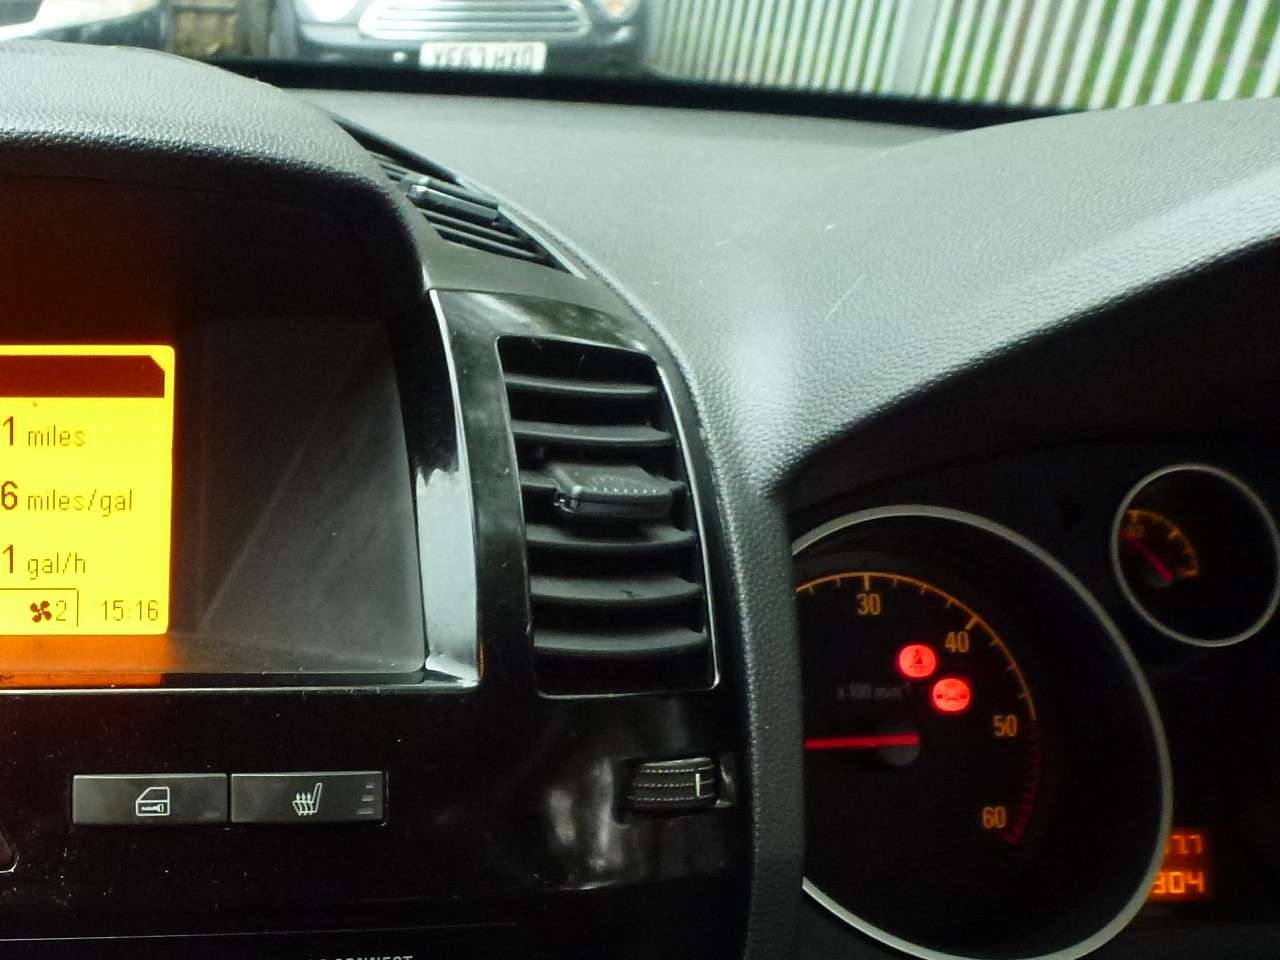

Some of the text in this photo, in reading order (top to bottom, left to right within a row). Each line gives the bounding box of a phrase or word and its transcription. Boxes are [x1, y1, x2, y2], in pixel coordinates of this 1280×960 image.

[27, 423, 87, 447] miles
[26, 488, 134, 518] miles/gal
[27, 551, 87, 581] gal/h
[55, 599, 68, 623] 2
[100, 599, 160, 622] 15:16
[856, 592, 881, 616] 30
[943, 630, 970, 653] 40
[993, 714, 1018, 738] 50
[981, 805, 1007, 829] 60
